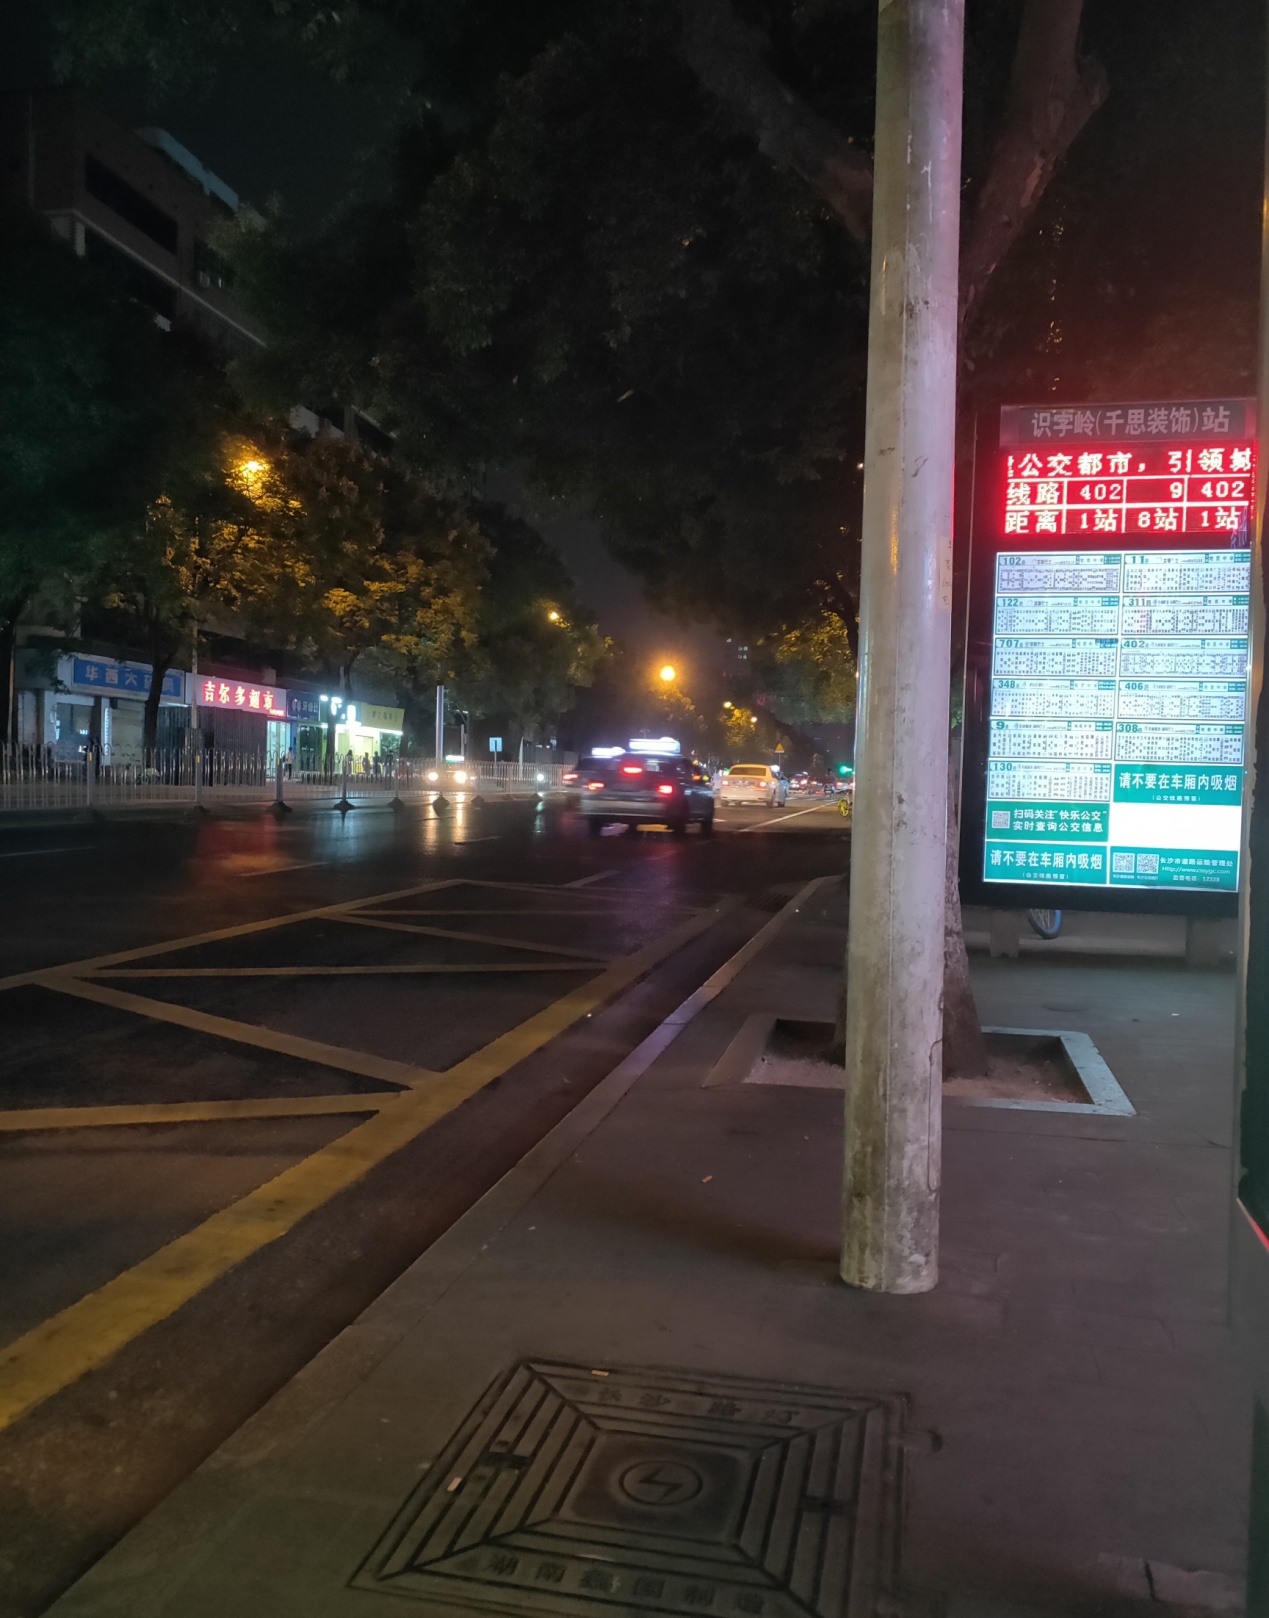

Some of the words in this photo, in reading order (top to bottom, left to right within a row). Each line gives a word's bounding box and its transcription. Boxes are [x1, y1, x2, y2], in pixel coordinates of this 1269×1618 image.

[1031, 405, 1230, 438] 识字岭(千思装饰)站
[1006, 482, 1060, 505] 线路
[1079, 483, 1122, 501] 402
[1169, 481, 1183, 499] 9
[1200, 480, 1245, 499] 402
[1004, 509, 1060, 533] 距离
[1080, 508, 1118, 532] 1站
[1137, 507, 1179, 531] 8站
[1200, 506, 1241, 530] 1站
[204, 680, 274, 711] 吉尔多超市
[1118, 772, 1238, 792] 请不要在车厢内吸烟
[1012, 820, 1104, 833] 实时查询公交信息
[990, 848, 1103, 870] 请不要在车厢内吸烟
